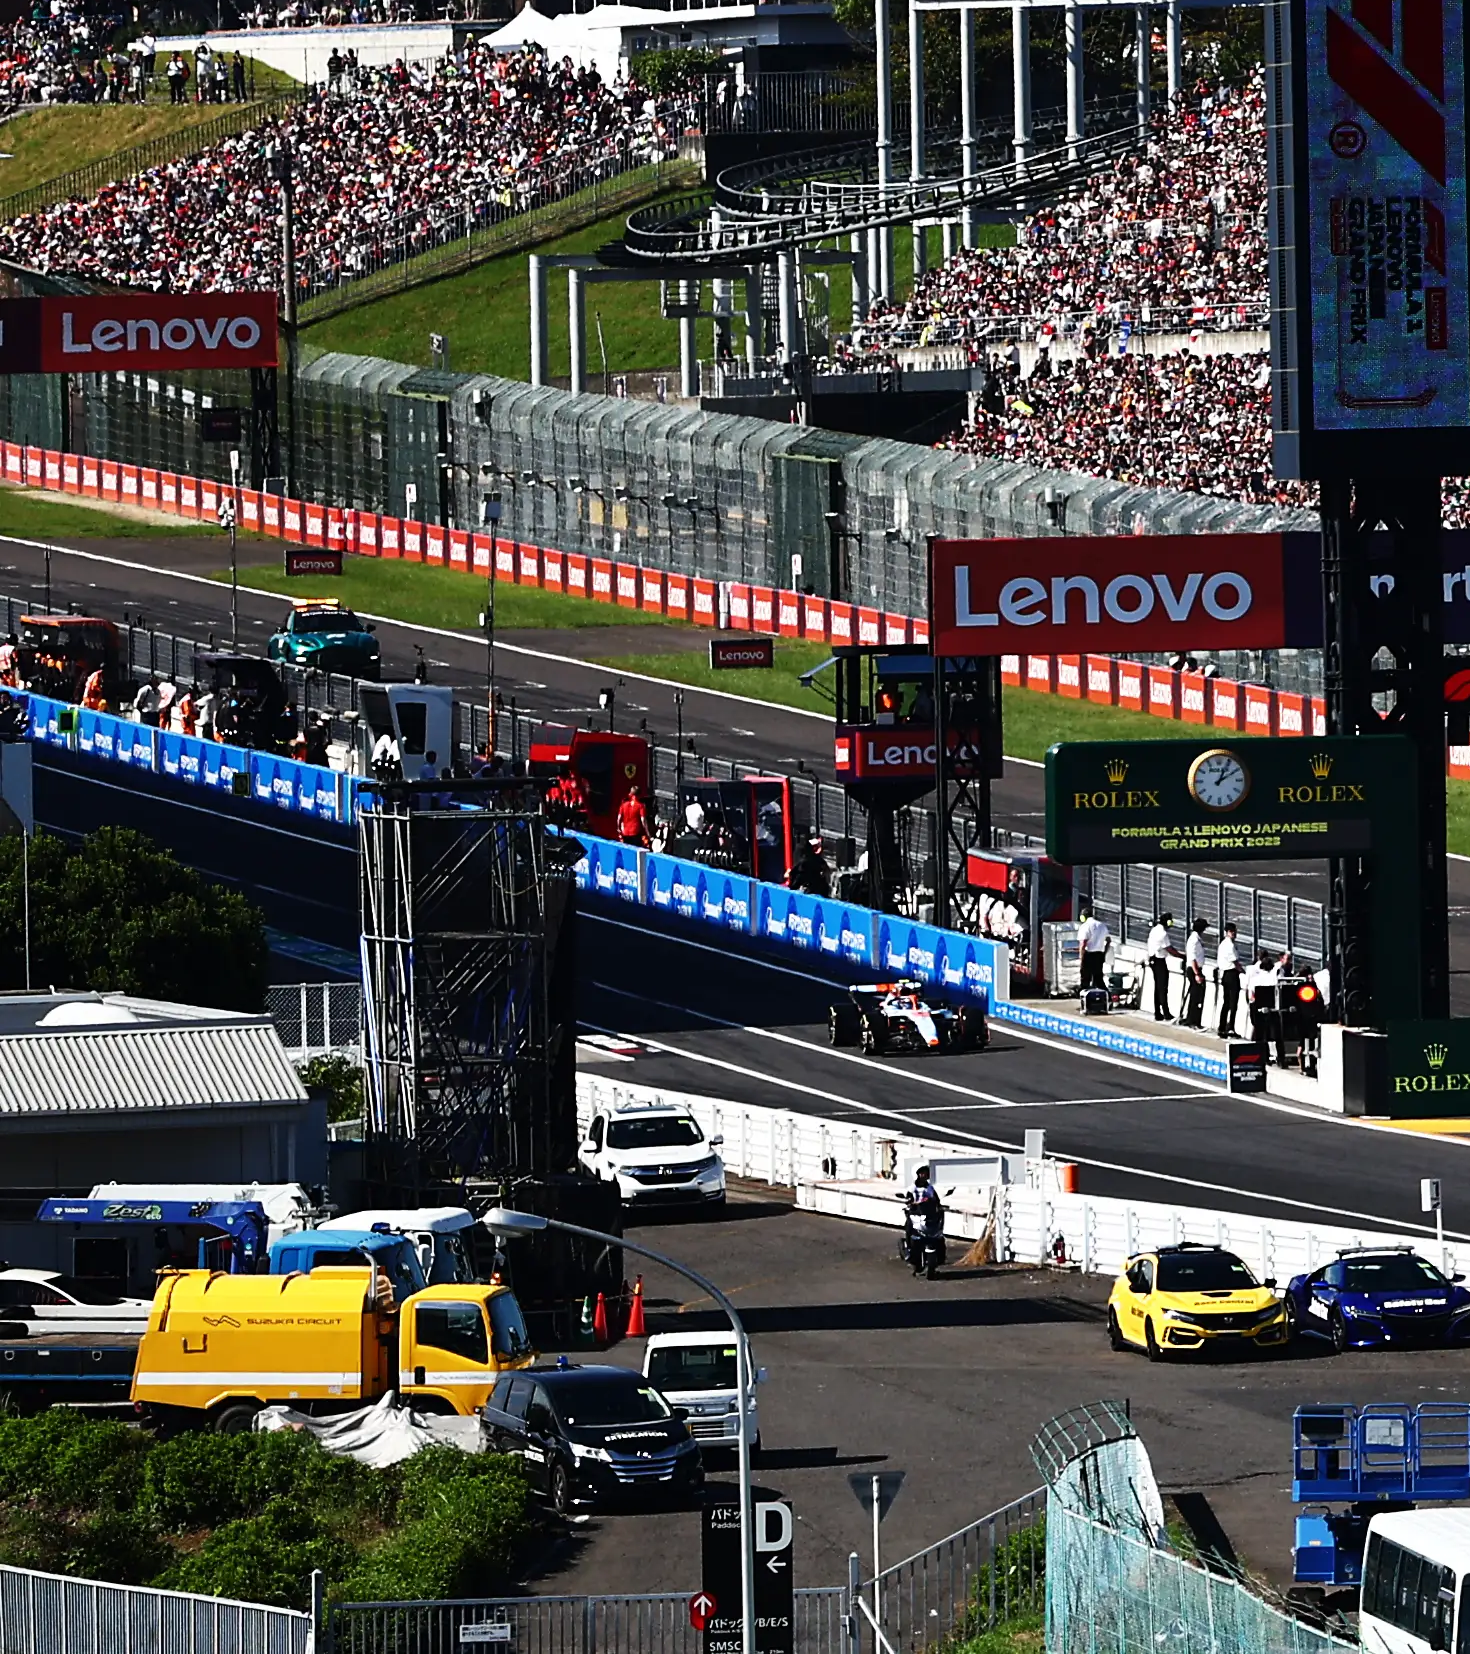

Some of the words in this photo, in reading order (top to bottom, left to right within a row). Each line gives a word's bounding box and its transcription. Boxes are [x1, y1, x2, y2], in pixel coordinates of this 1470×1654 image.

[62, 313, 261, 353] Lenovo
[293, 559, 335, 570] Lenovo
[955, 565, 1252, 627] Lenovo
[719, 650, 764, 661] Lenovo
[868, 742, 979, 765] Leno
[1074, 790, 1161, 808] ROLEX
[1278, 785, 1364, 803] ROLEX
[1112, 826, 1181, 838] FORMULA
[1184, 826, 1192, 836] 1
[1194, 824, 1251, 836] LENOVO
[1254, 822, 1328, 835] JAPANESE
[1160, 837, 1209, 849] GRAND
[1212, 837, 1244, 848] PRIX
[1247, 835, 1280, 846] 2023
[755, 1502, 792, 1552] D
[709, 1641, 741, 1652] SMSC
